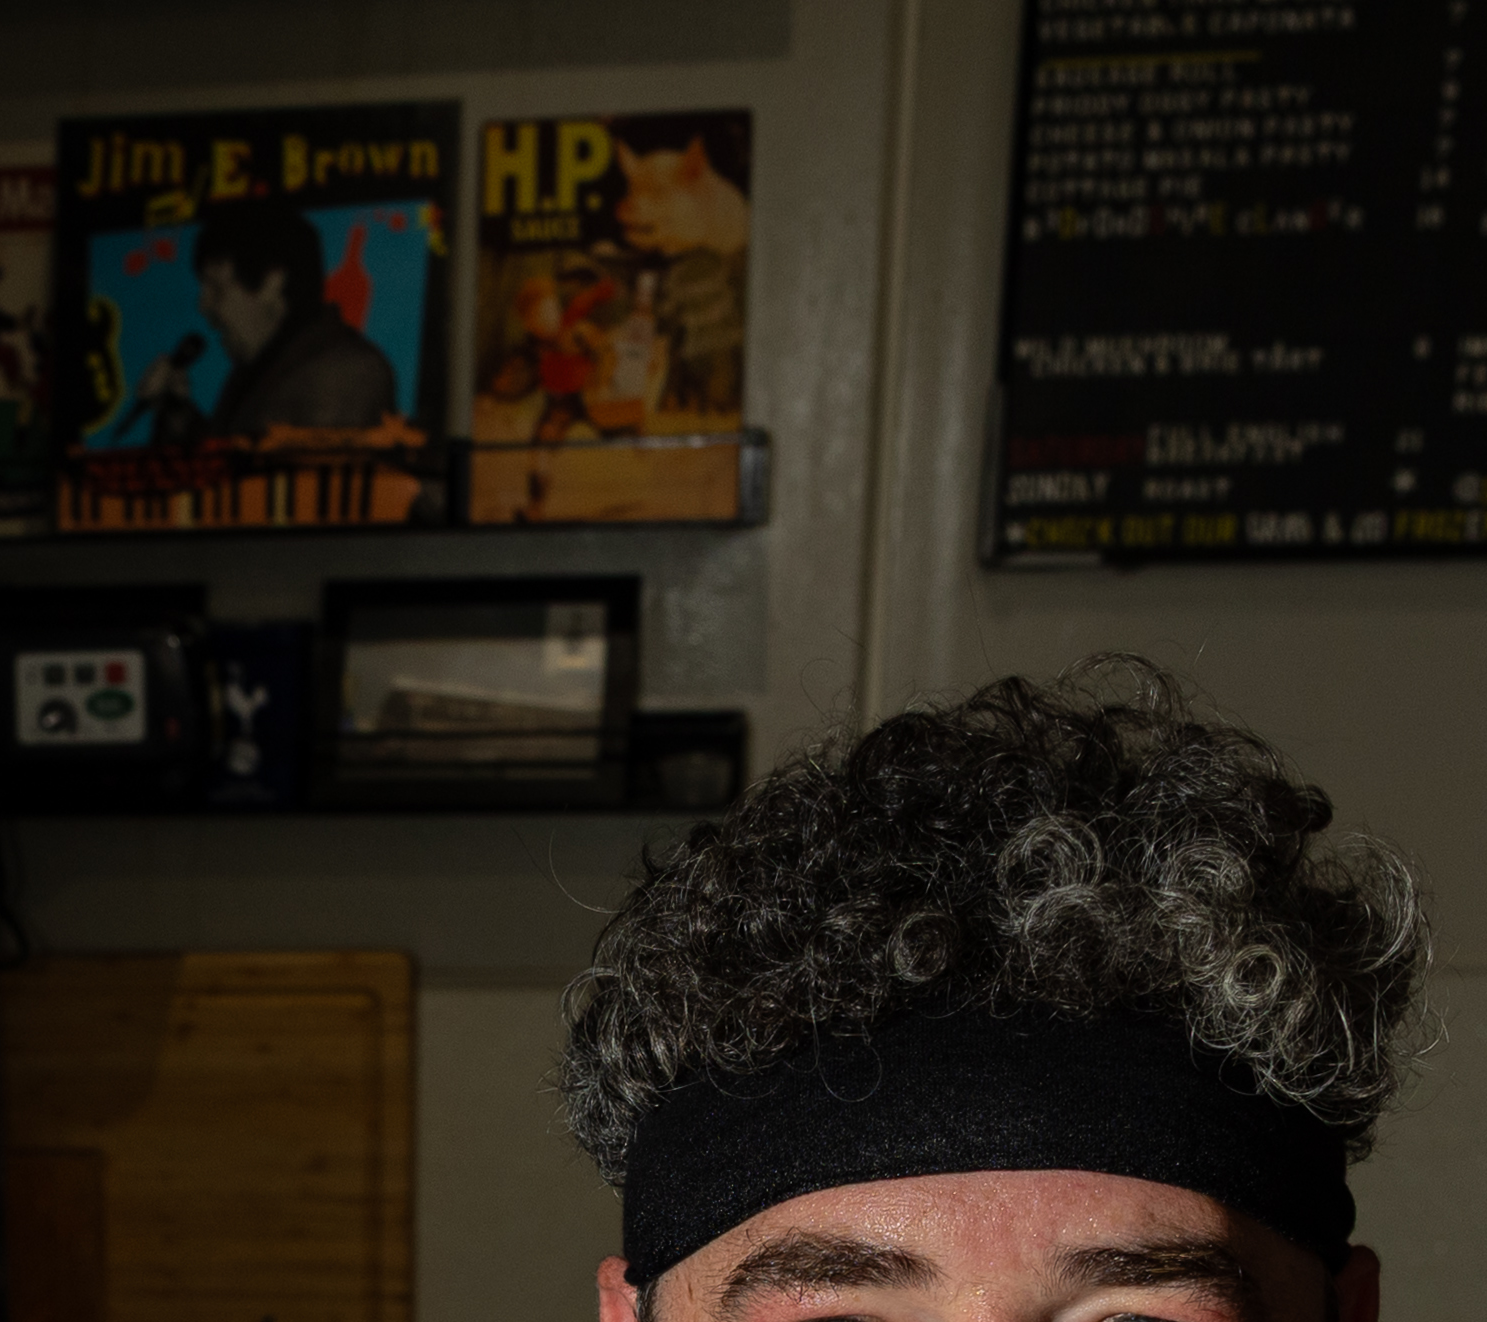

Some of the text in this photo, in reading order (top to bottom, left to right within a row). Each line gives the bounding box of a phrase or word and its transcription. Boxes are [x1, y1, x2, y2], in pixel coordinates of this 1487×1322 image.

[74, 130, 441, 201] Jim E. Brown
[1121, 512, 1176, 547] OUT
